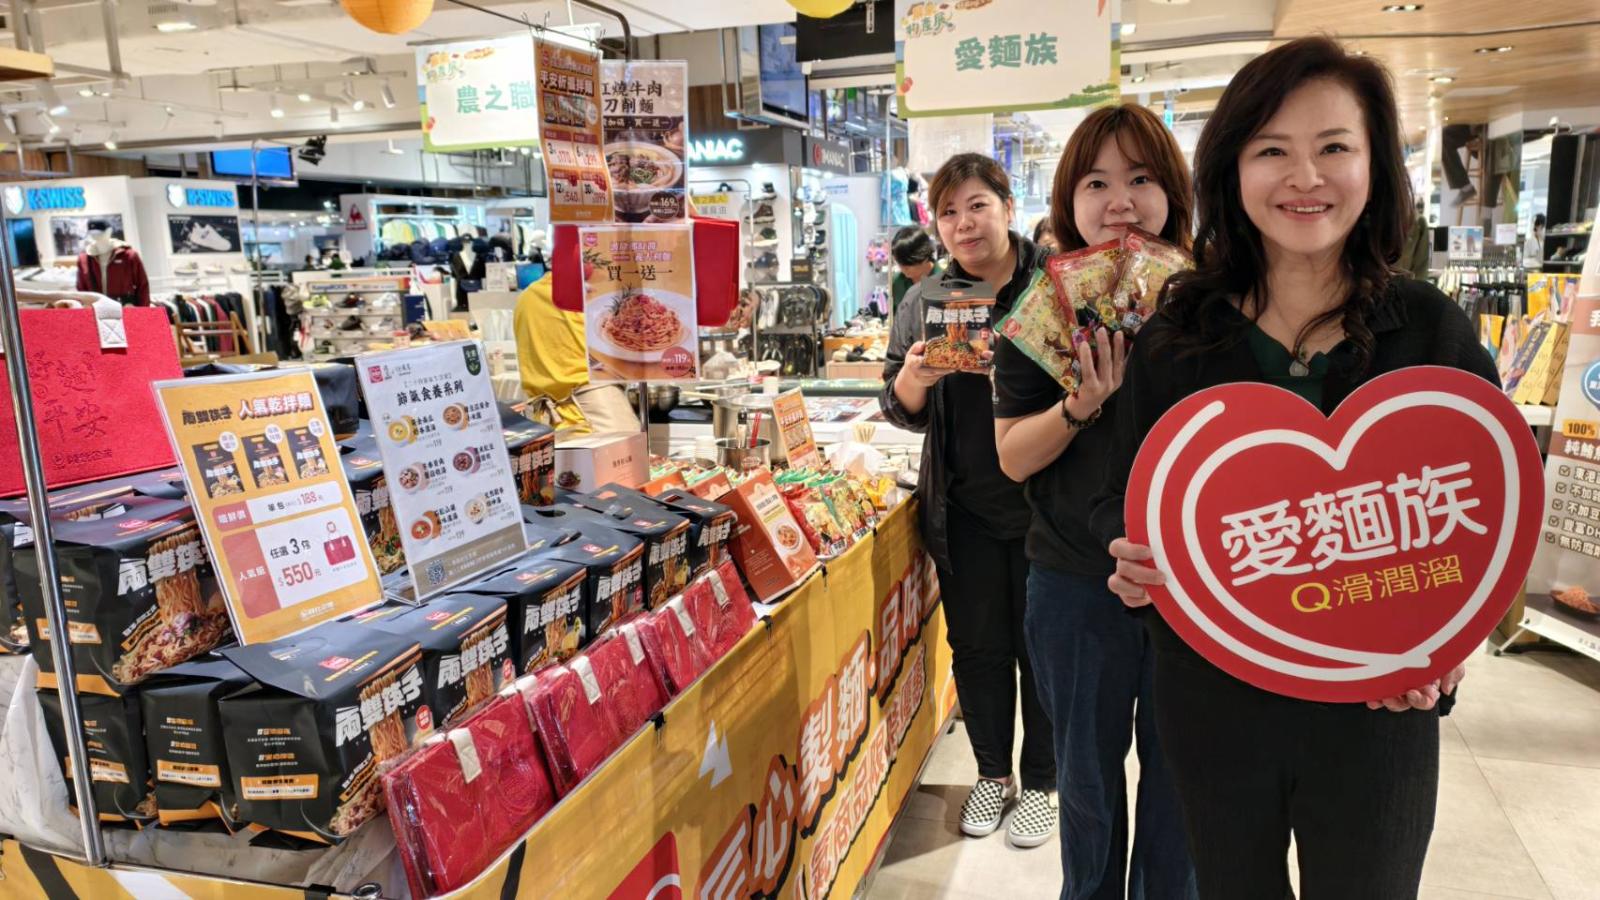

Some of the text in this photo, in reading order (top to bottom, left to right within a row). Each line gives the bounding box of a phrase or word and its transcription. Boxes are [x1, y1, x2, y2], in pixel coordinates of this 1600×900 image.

[954, 31, 1058, 72] 愛麵族
[604, 98, 654, 114] 刀削麵
[26, 186, 86, 210] K-SWISS
[185, 188, 236, 208] K-SWISS
[606, 264, 673, 282] 買一送一
[396, 380, 465, 407] 節氣食養系列
[1567, 422, 1596, 436] 100%
[1567, 501, 1600, 520] 不加豆
[1220, 460, 1488, 587] 愛麵族
[291, 537, 303, 555] 3
[117, 539, 210, 597] 兩雙筷
[1290, 554, 1464, 613] Q滑潤溜
[436, 621, 510, 691] 兩雙筷子
[334, 663, 424, 748] 兩雙筷子
